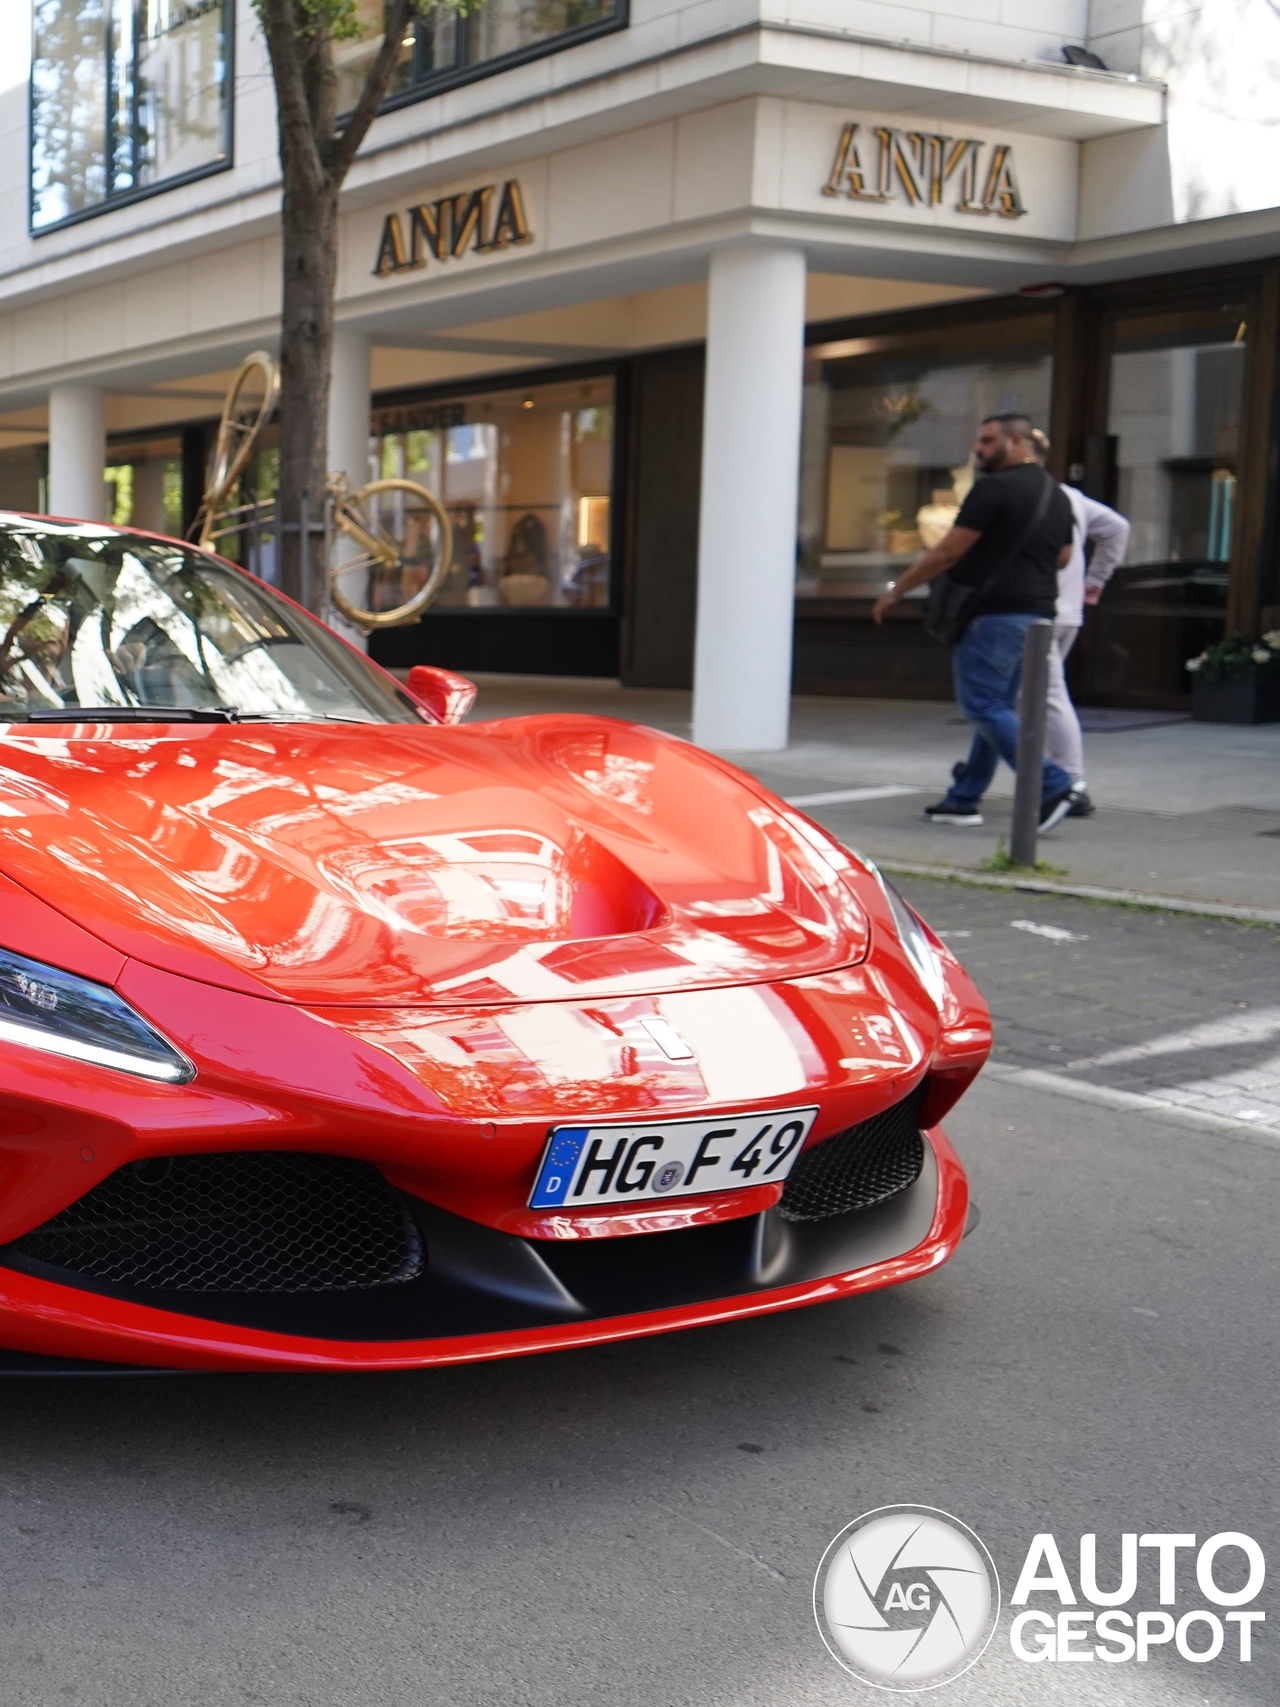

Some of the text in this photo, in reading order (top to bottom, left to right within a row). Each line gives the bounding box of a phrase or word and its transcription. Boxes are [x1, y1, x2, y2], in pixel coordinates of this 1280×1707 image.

[545, 1120, 806, 1196] D HG F 49
